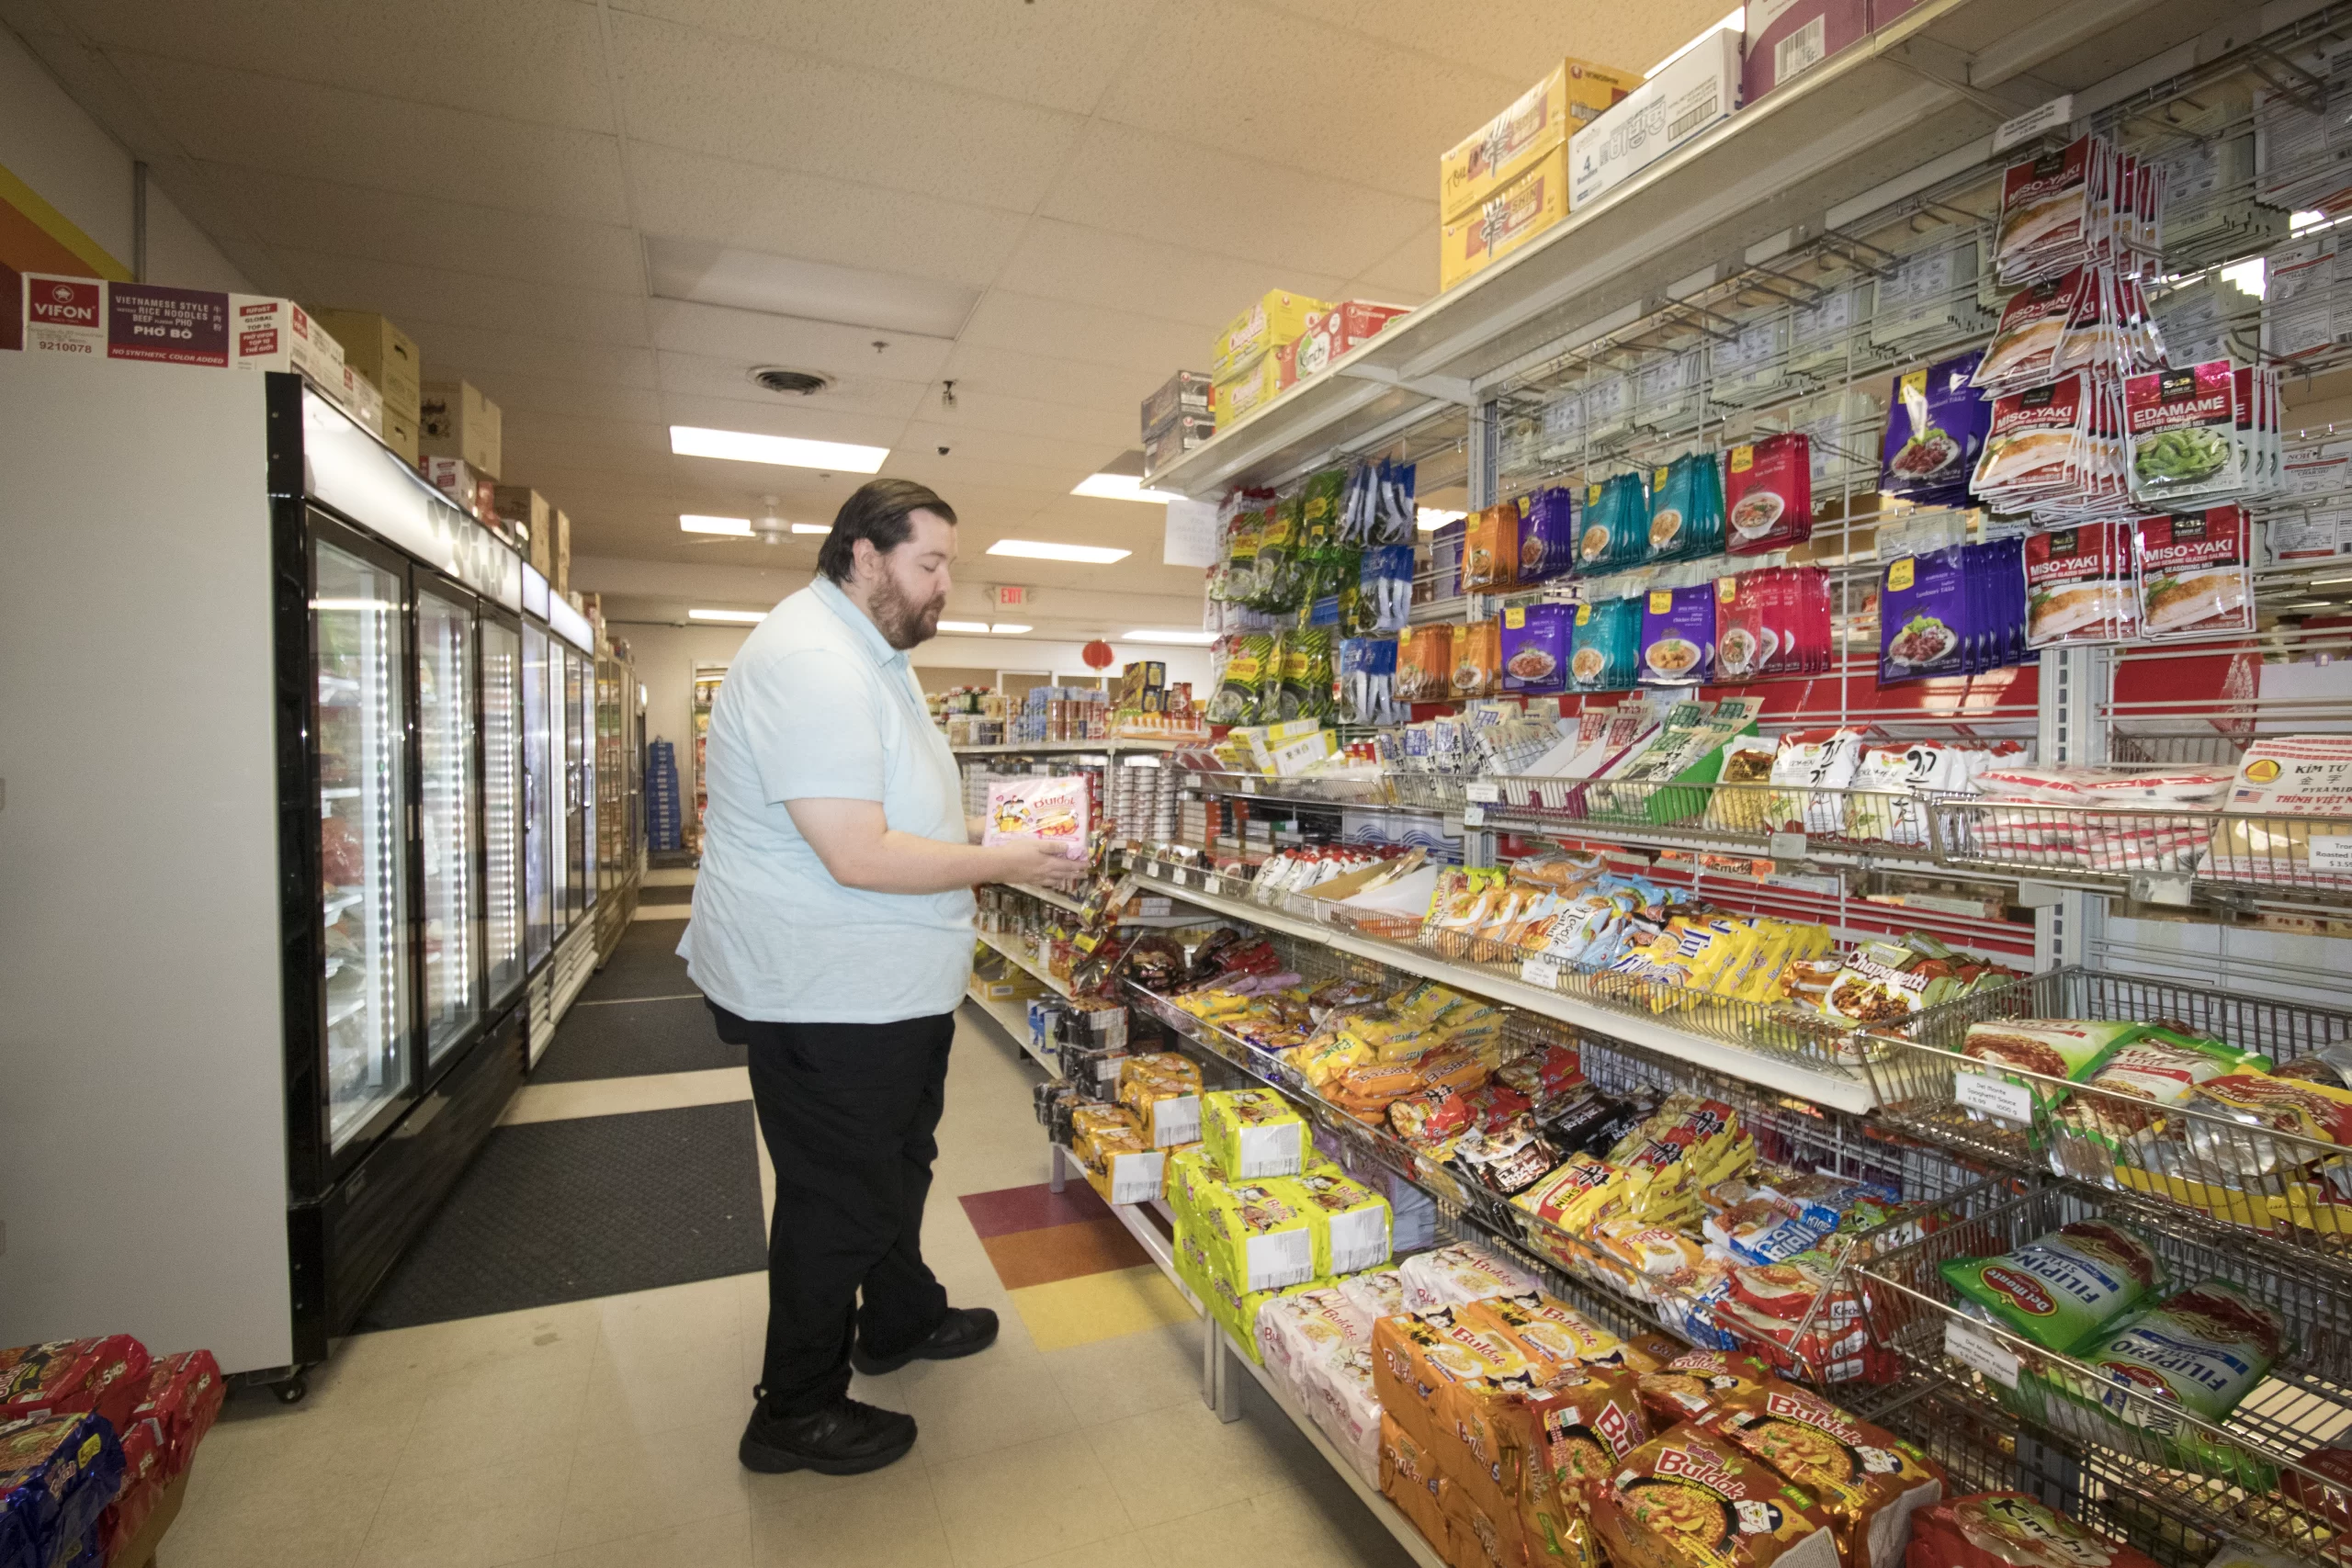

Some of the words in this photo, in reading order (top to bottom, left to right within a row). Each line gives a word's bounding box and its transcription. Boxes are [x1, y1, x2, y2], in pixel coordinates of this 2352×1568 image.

[1583, 154, 1591, 172] 4
[34, 302, 93, 320] VIFON
[115, 296, 177, 310] VIETNAMESE
[179, 301, 209, 313] STYLE
[139, 306, 161, 316] RICE
[164, 309, 209, 321] NOODLES
[132, 314, 153, 323] BEEF
[244, 315, 273, 323] GLOBAL
[40, 341, 93, 354] 9210078
[125, 350, 167, 359] SYNTHETIC
[169, 354, 196, 362] COLOR
[197, 356, 224, 365] ADDED
[1996, 406, 2073, 429] MISO-YAKI
[2134, 418, 2164, 430] WASABI
[2155, 421, 2192, 434] SEASONING
[2192, 419, 2205, 427] MIX
[2145, 539, 2233, 561] MISO-YAKI
[2030, 555, 2098, 576] MISO-YAKI
[2164, 563, 2200, 573] SEASONING
[1001, 587, 1023, 604] EXIT
[2316, 794, 2345, 806] VIỆT
[1550, 906, 1592, 948] Noodle
[1845, 950, 1929, 992] Chapagetti
[2124, 1057, 2165, 1066] STYLE
[1967, 1088, 1996, 1102] Spaghetti
[1996, 1096, 2017, 1107] Sauce
[1976, 1082, 1987, 1090] Del
[1989, 1086, 2007, 1096] Monte
[2233, 1083, 2294, 1094] PARMESAN
[1996, 1104, 2012, 1113] 1000
[1555, 1186, 1583, 1211] SHIN
[2041, 1255, 2079, 1274] STYLE
[1986, 1268, 2028, 1297] Monte
[2024, 1293, 2050, 1313] Del
[1321, 1308, 1357, 1342] Buldak
[1541, 1306, 1598, 1348] Buldak
[1451, 1326, 1507, 1367] Buldak
[1965, 1338, 1974, 1348] Del
[1976, 1344, 1995, 1358] Monte
[2110, 1339, 2229, 1393] FILIPINO
[2129, 1368, 2160, 1388] Quality
[1767, 1393, 1863, 1447] Buldak
[1655, 1447, 1747, 1499] Buldak
[2320, 1461, 2334, 1471] NET
[1653, 1472, 1683, 1484] Artificial
[1683, 1478, 1700, 1489] Spicy
[1682, 1485, 1717, 1504] Ramen
[1787, 1488, 1810, 1506] NEW
[1991, 1498, 2095, 1560] Kimchi
[1685, 1538, 1710, 1557] Ramen
